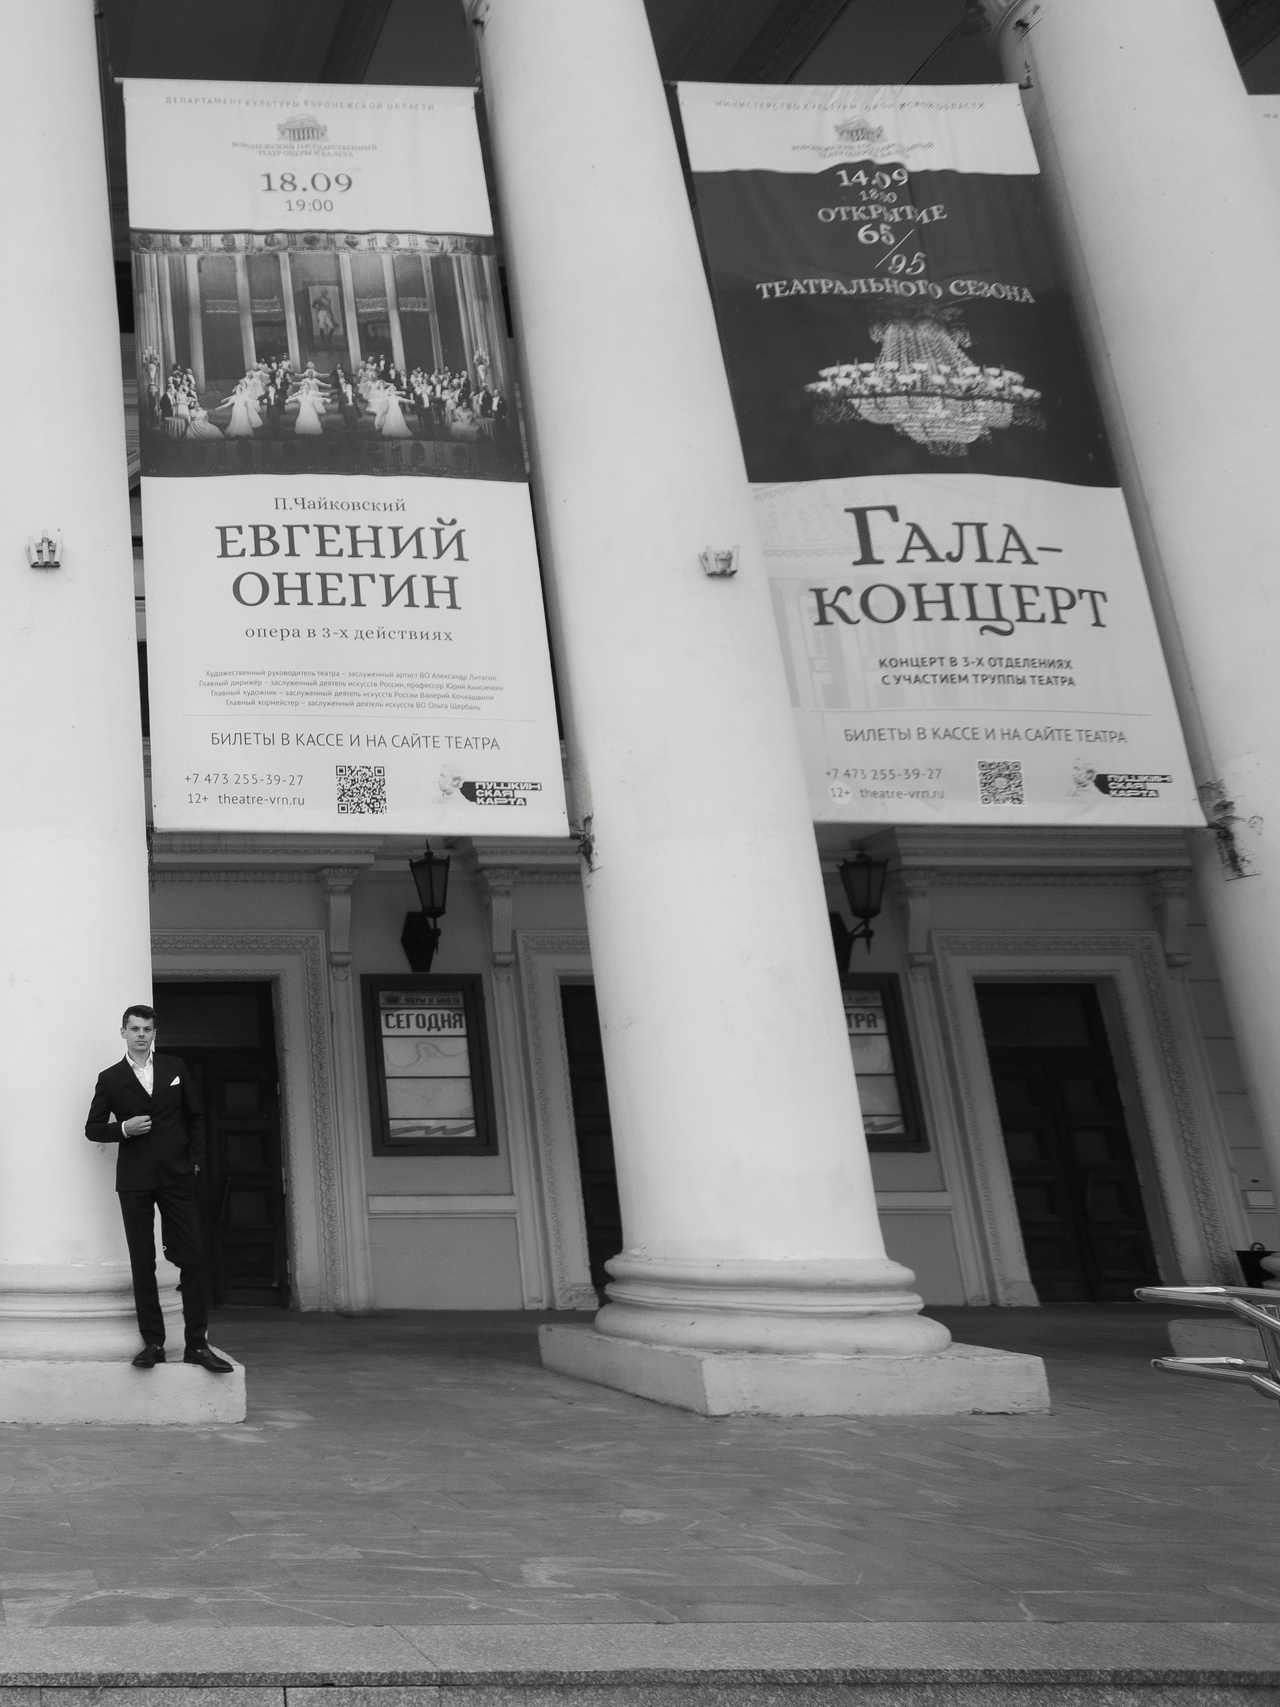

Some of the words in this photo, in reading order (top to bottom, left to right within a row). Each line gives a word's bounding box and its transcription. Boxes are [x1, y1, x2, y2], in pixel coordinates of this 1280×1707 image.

[259, 171, 353, 193] 18.09
[836, 168, 908, 189] 14.09
[286, 199, 334, 212] 19:00
[817, 204, 947, 224] ОТКРЫТИЕ
[756, 278, 942, 299] ТЕАТРАЛЬНОГО
[948, 279, 1036, 303] СЕЗОНА
[274, 496, 406, 512] П.Чайковский
[215, 517, 469, 561] ЕВГЕНИЙ
[233, 572, 461, 610] ОНЕГИН
[244, 627, 301, 641] опера
[307, 628, 317, 638] в
[322, 627, 349, 639] 3-х
[354, 626, 453, 642] действиях
[878, 656, 946, 669] КОНЦЕРТ
[949, 656, 958, 668] В
[962, 656, 985, 669] 3-Х
[987, 656, 1073, 670] ОТДЕЛЕНИЯХ
[206, 669, 265, 678] Художественный
[881, 674, 891, 685] С
[893, 673, 969, 686] УЧАСТИЕМ
[972, 673, 1027, 686] ТРУППЫ
[1029, 674, 1076, 687] ТЕАТРА
[407, 682, 444, 690] профессор
[420, 692, 450, 700] Валерий
[211, 732, 275, 746] БИЛЕТЫ
[281, 732, 291, 746] В
[296, 733, 344, 747] КАССЕ
[349, 733, 361, 747] И
[366, 734, 387, 748] НА
[391, 732, 441, 749] САЙТЕ
[445, 735, 501, 750] ТЕАТРА
[843, 727, 911, 742] БИЛЕТЫ
[917, 727, 927, 741] В
[931, 726, 980, 741] КАССЕ
[985, 727, 996, 741] И
[1000, 727, 1023, 742] НА
[1024, 725, 1073, 743] САЙТЕ
[1075, 729, 1128, 743] ТЕАТРА
[184, 773, 200, 784] +7
[204, 773, 229, 785] 473
[234, 773, 304, 786] 255-39-27
[825, 768, 840, 779] +7
[842, 768, 867, 780] 473
[871, 767, 942, 781] 255-39-27
[475, 782, 542, 790] ПУШКИН
[830, 786, 850, 798] 12+
[859, 786, 945, 800] theatre-vrn.ru
[187, 793, 209, 804] 12+
[218, 793, 305, 806] theatre-vrn.ru
[475, 797, 527, 806] КАРТА
[384, 1012, 464, 1032] СЕГОДНЯ
